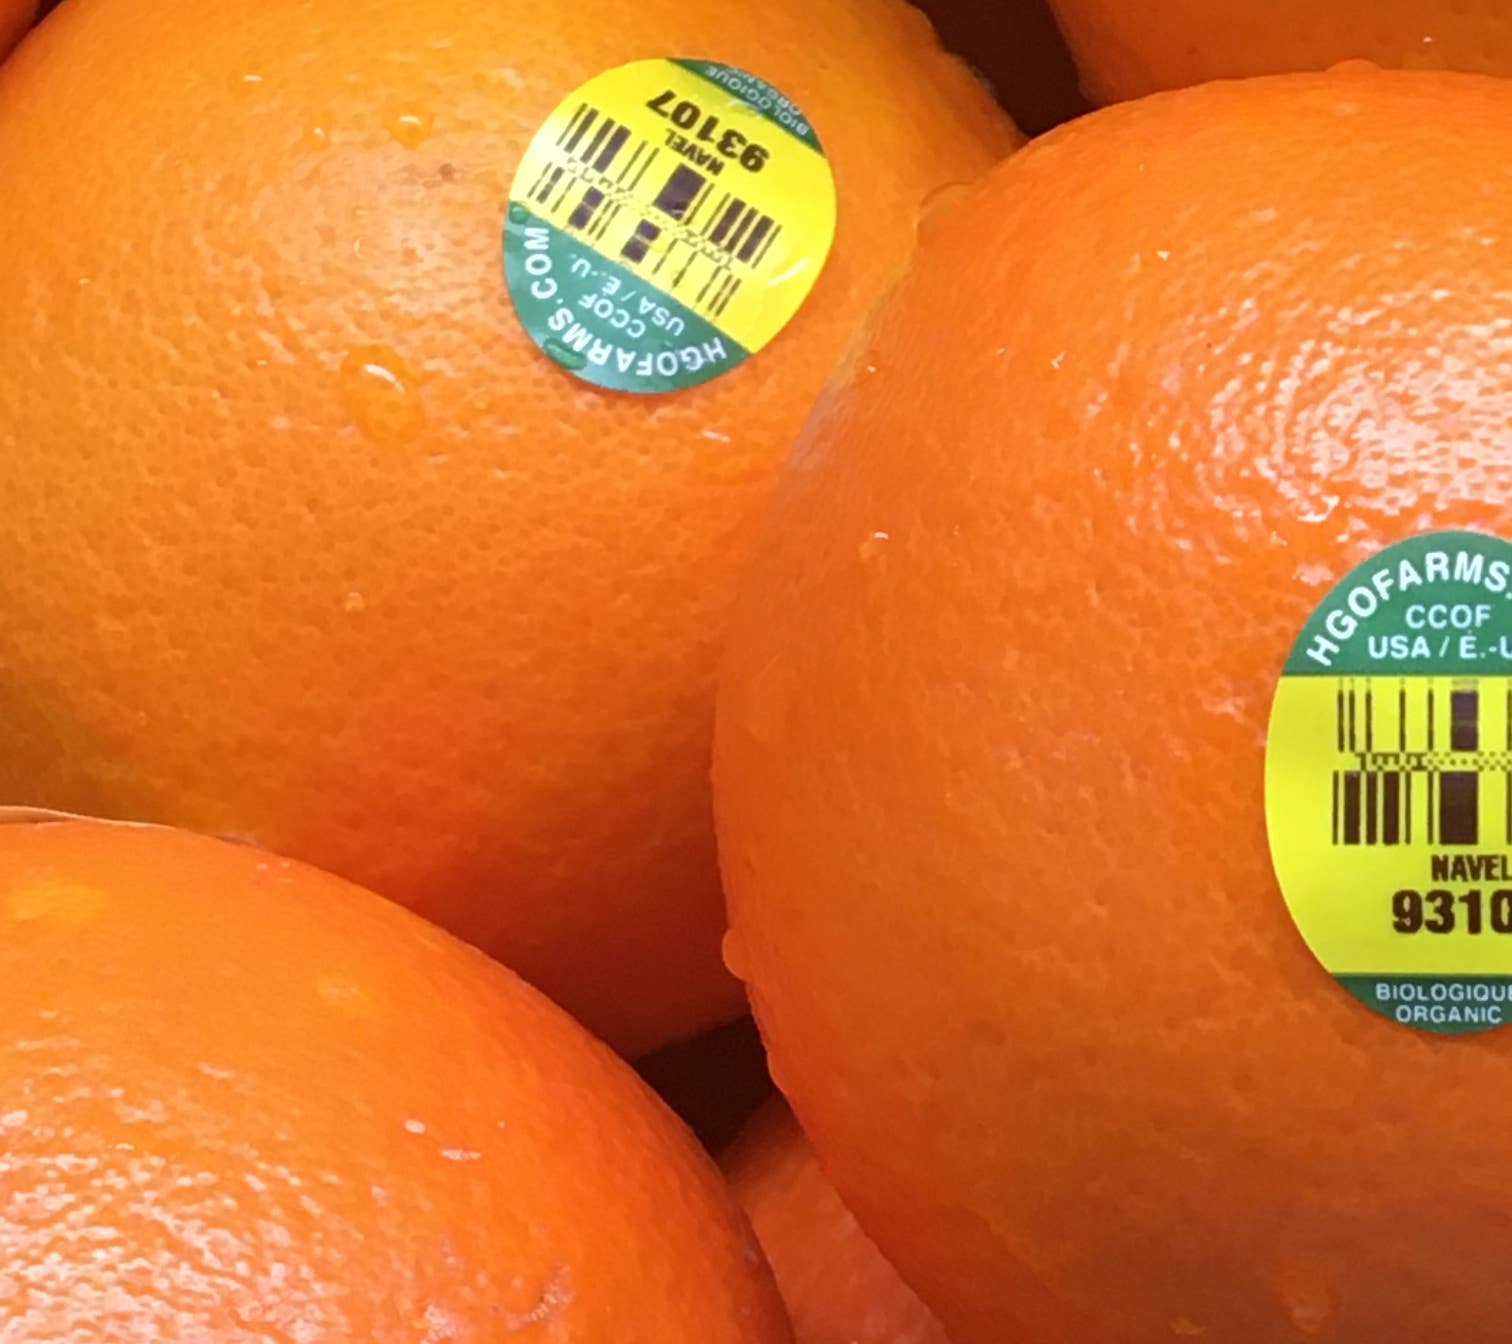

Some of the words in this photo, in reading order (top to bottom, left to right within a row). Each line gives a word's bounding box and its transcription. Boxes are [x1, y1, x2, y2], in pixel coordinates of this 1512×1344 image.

[705, 65, 810, 136] BIOLOGIQUE
[646, 89, 770, 173] 93107
[664, 128, 725, 176] NAVEL
[523, 227, 727, 377] HGOFARMS.COM
[577, 293, 646, 338] CCOF
[639, 296, 685, 337] USA
[1405, 603, 1492, 629] CCOF
[1368, 635, 1431, 660] USA
[1395, 1004, 1503, 1026] ORGANIC
